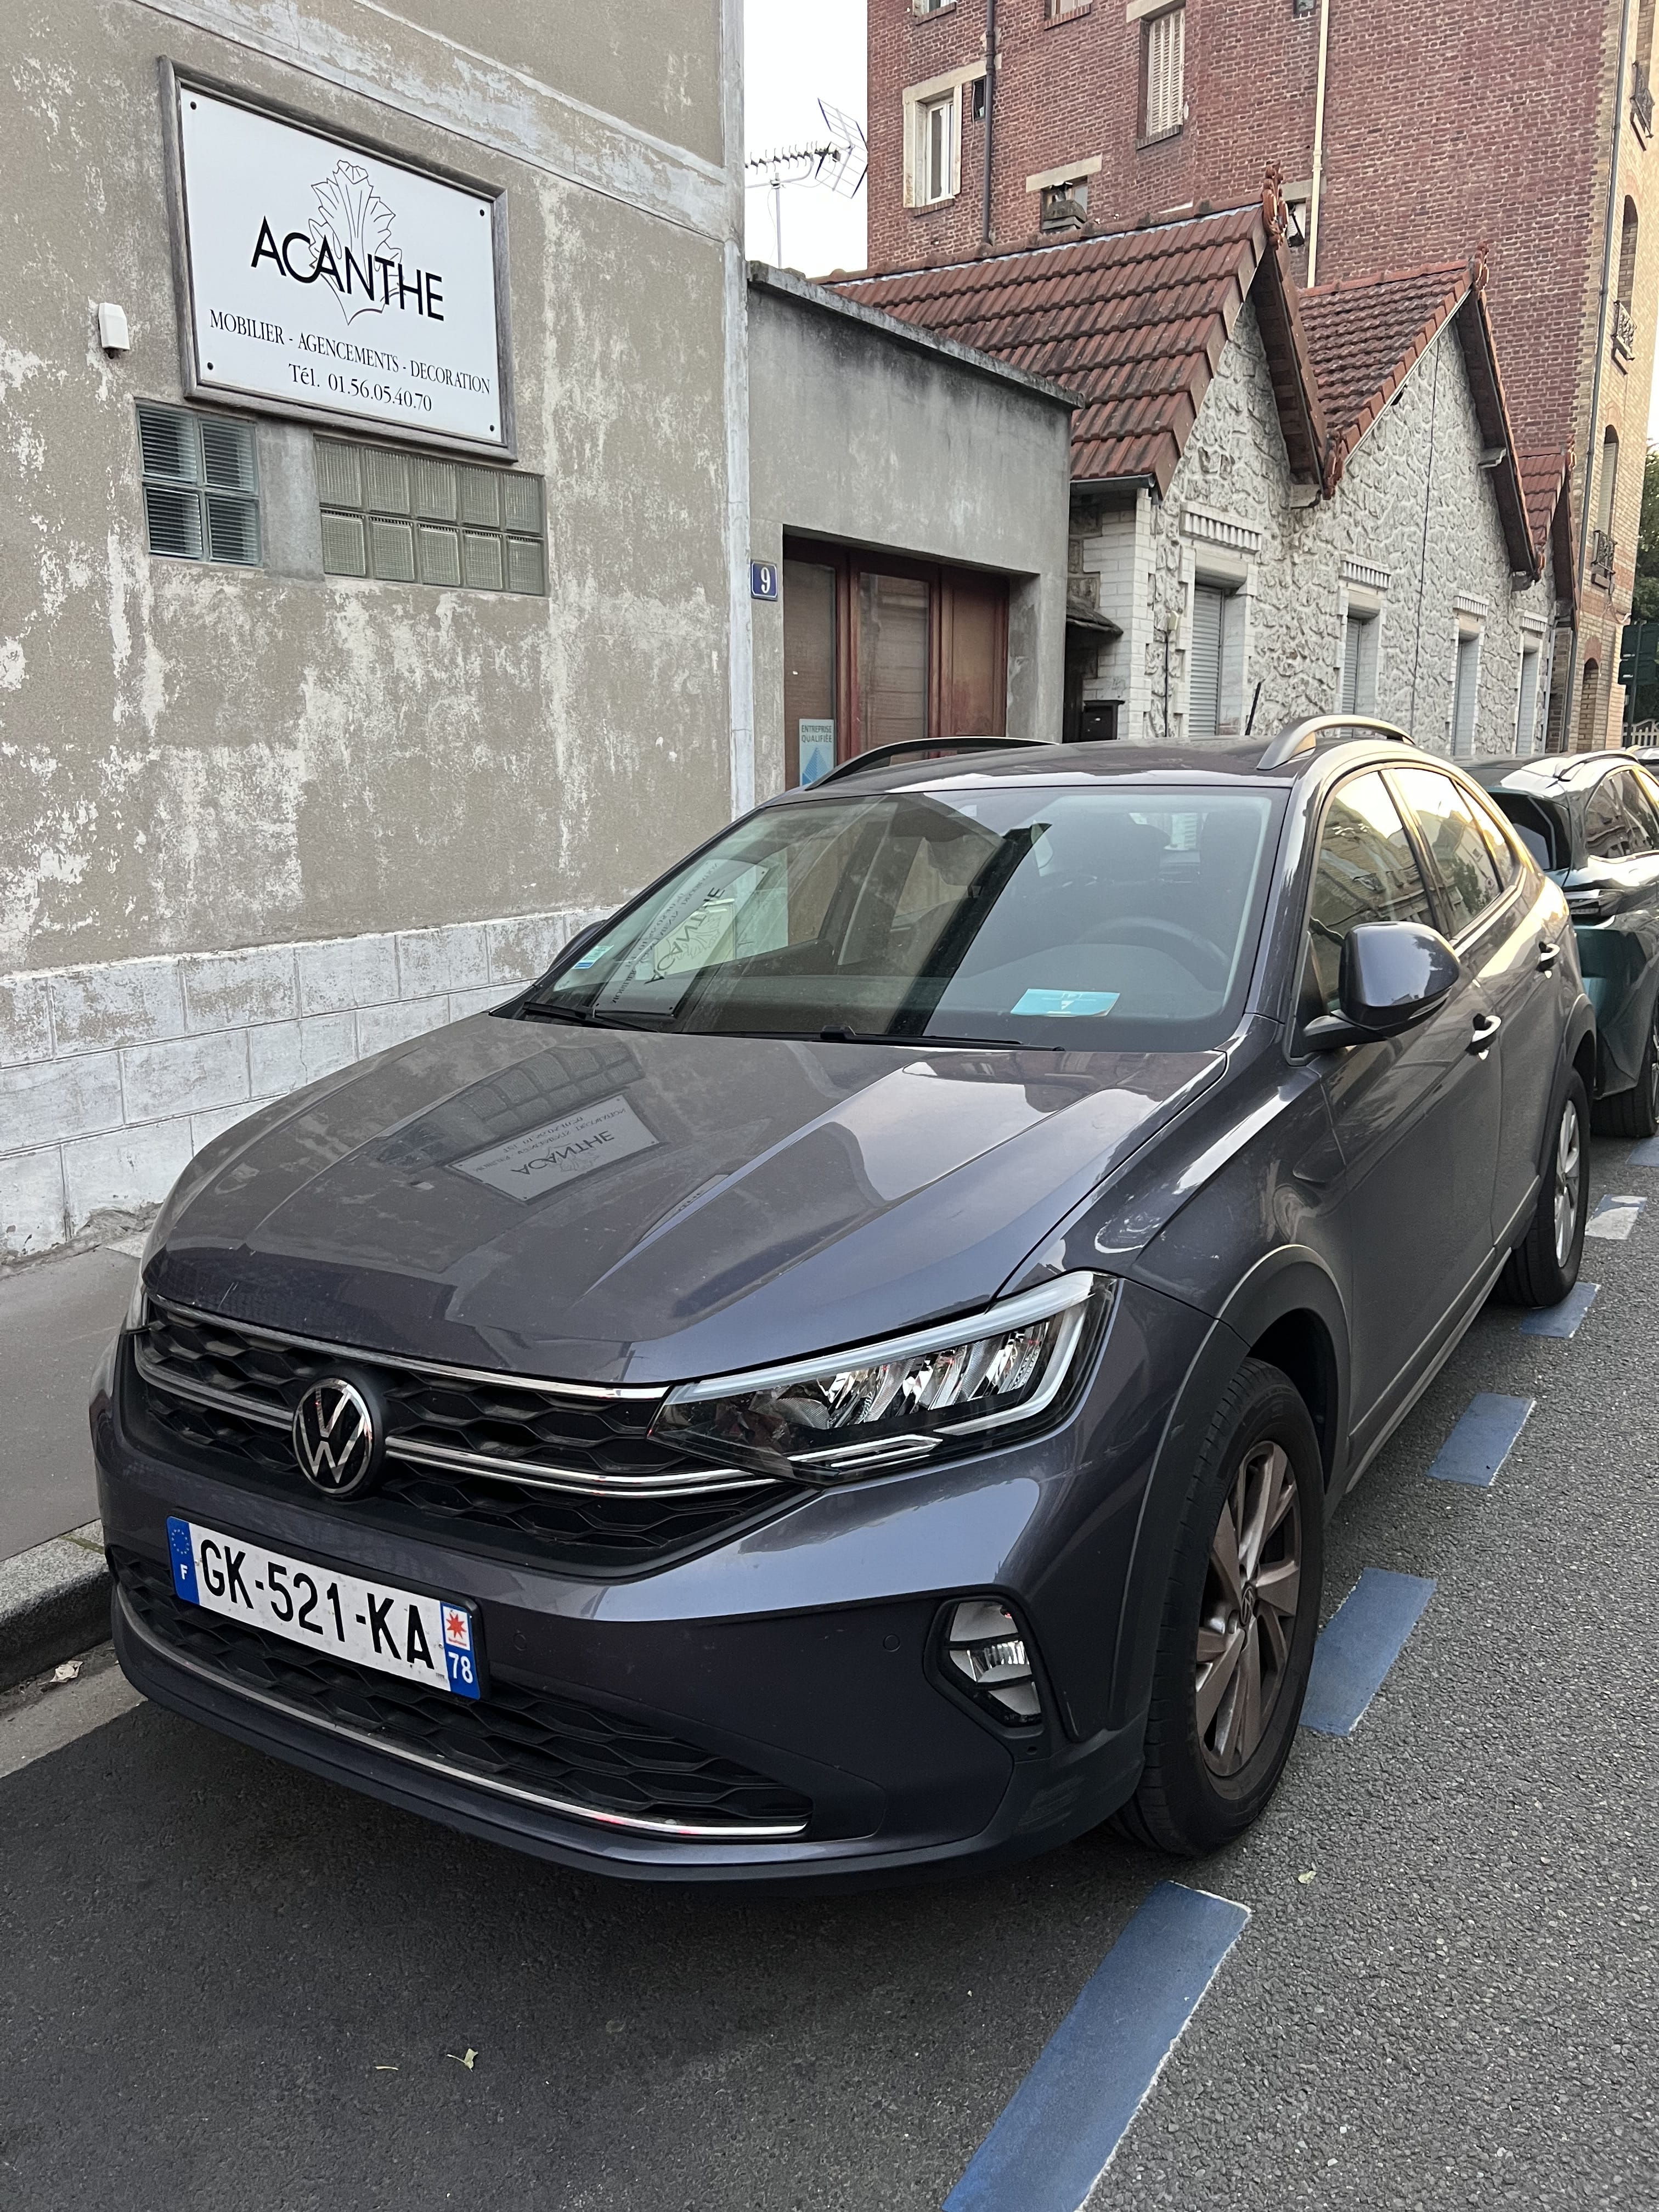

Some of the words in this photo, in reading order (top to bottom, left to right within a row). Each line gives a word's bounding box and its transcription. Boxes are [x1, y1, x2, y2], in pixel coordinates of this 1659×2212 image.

[251, 216, 444, 322] ACANTHE
[210, 308, 285, 346] MOBILIER
[297, 332, 399, 373] AGENCEMENTS
[410, 360, 490, 395] DECORATION
[289, 363, 320, 387] Tél.
[328, 373, 432, 411] 01.56.05.40.70
[760, 567, 771, 594] 9
[801, 725, 832, 733] ENTREPRISE
[802, 733, 832, 743] QUALIFIÉE
[180, 1564, 188, 1580] F
[200, 1539, 435, 1670] GK-521-KA
[448, 1651, 473, 1684] 78
